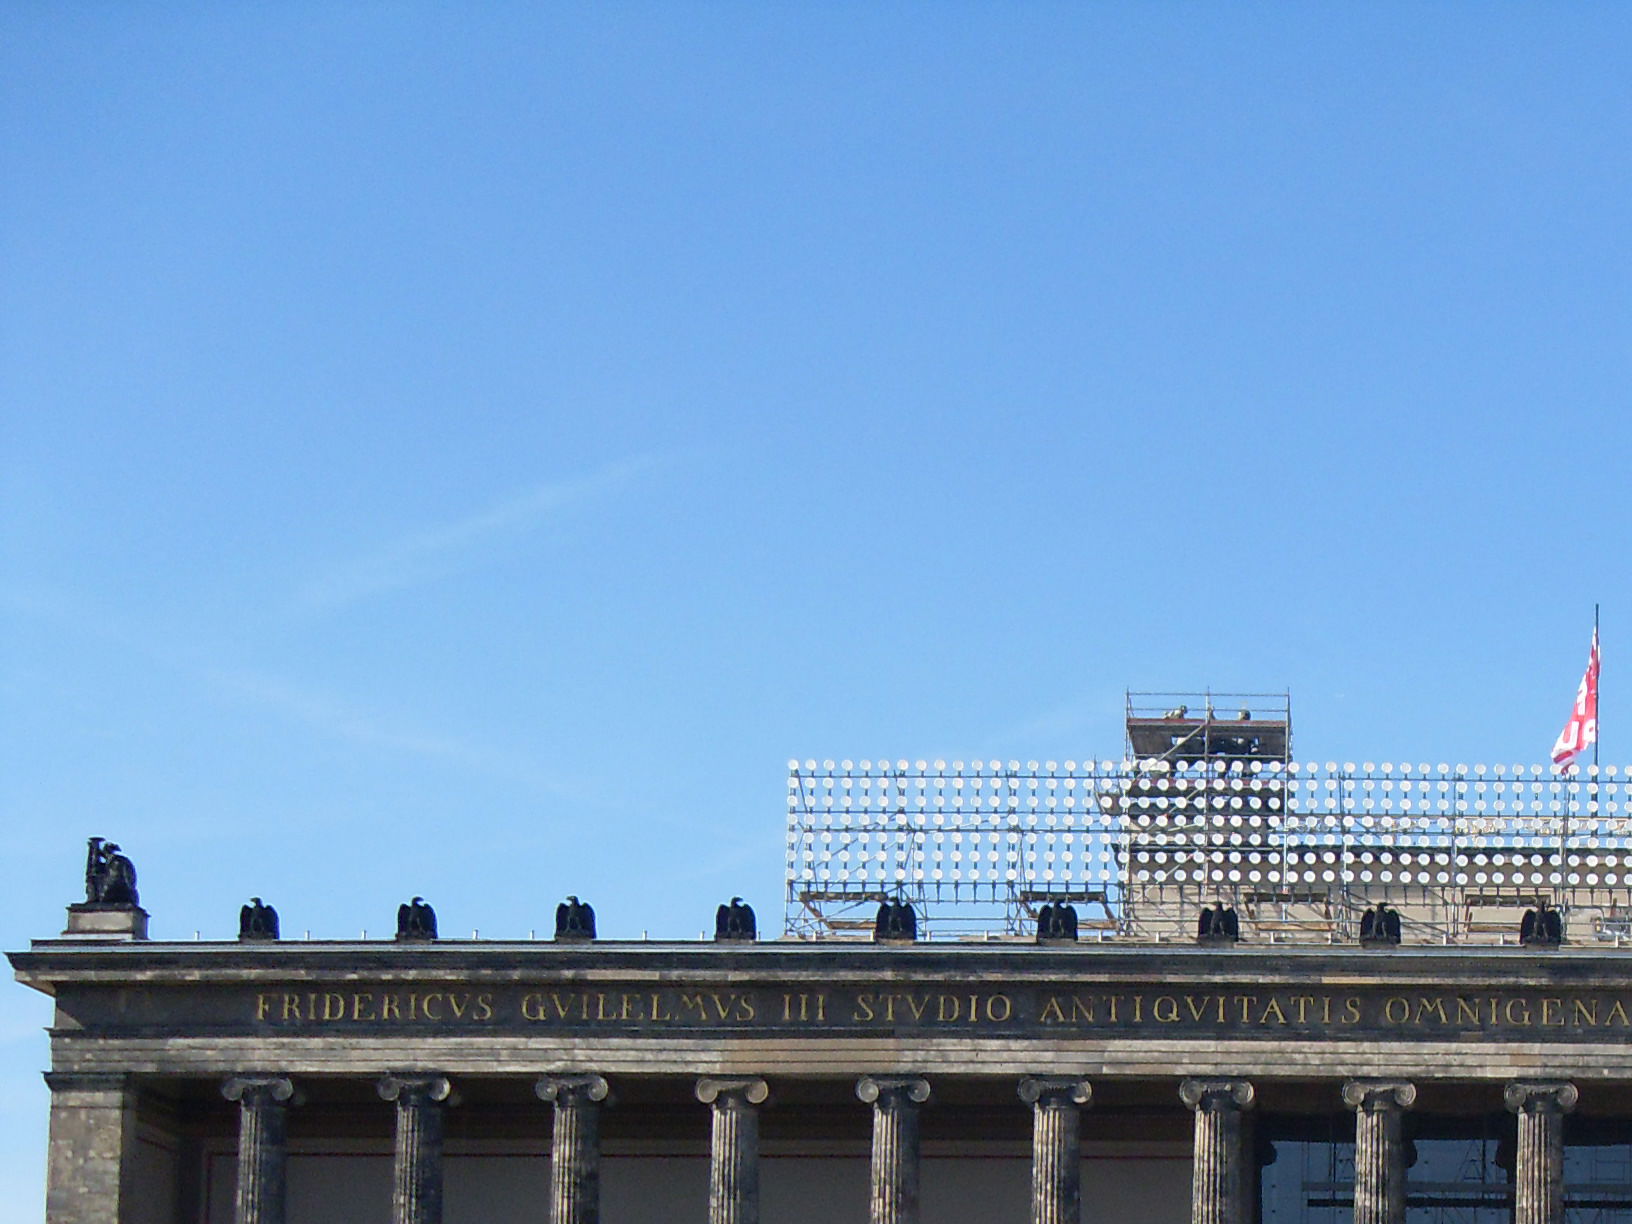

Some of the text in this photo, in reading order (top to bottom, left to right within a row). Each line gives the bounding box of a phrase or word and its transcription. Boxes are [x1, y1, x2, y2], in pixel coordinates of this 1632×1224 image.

[256, 993, 493, 1021] FRIDERICVS
[522, 993, 756, 1021] GVILELMVS
[783, 994, 826, 1021] III
[854, 994, 1012, 1023] STVDIO
[1040, 995, 1361, 1024] ANTIQVITATIS
